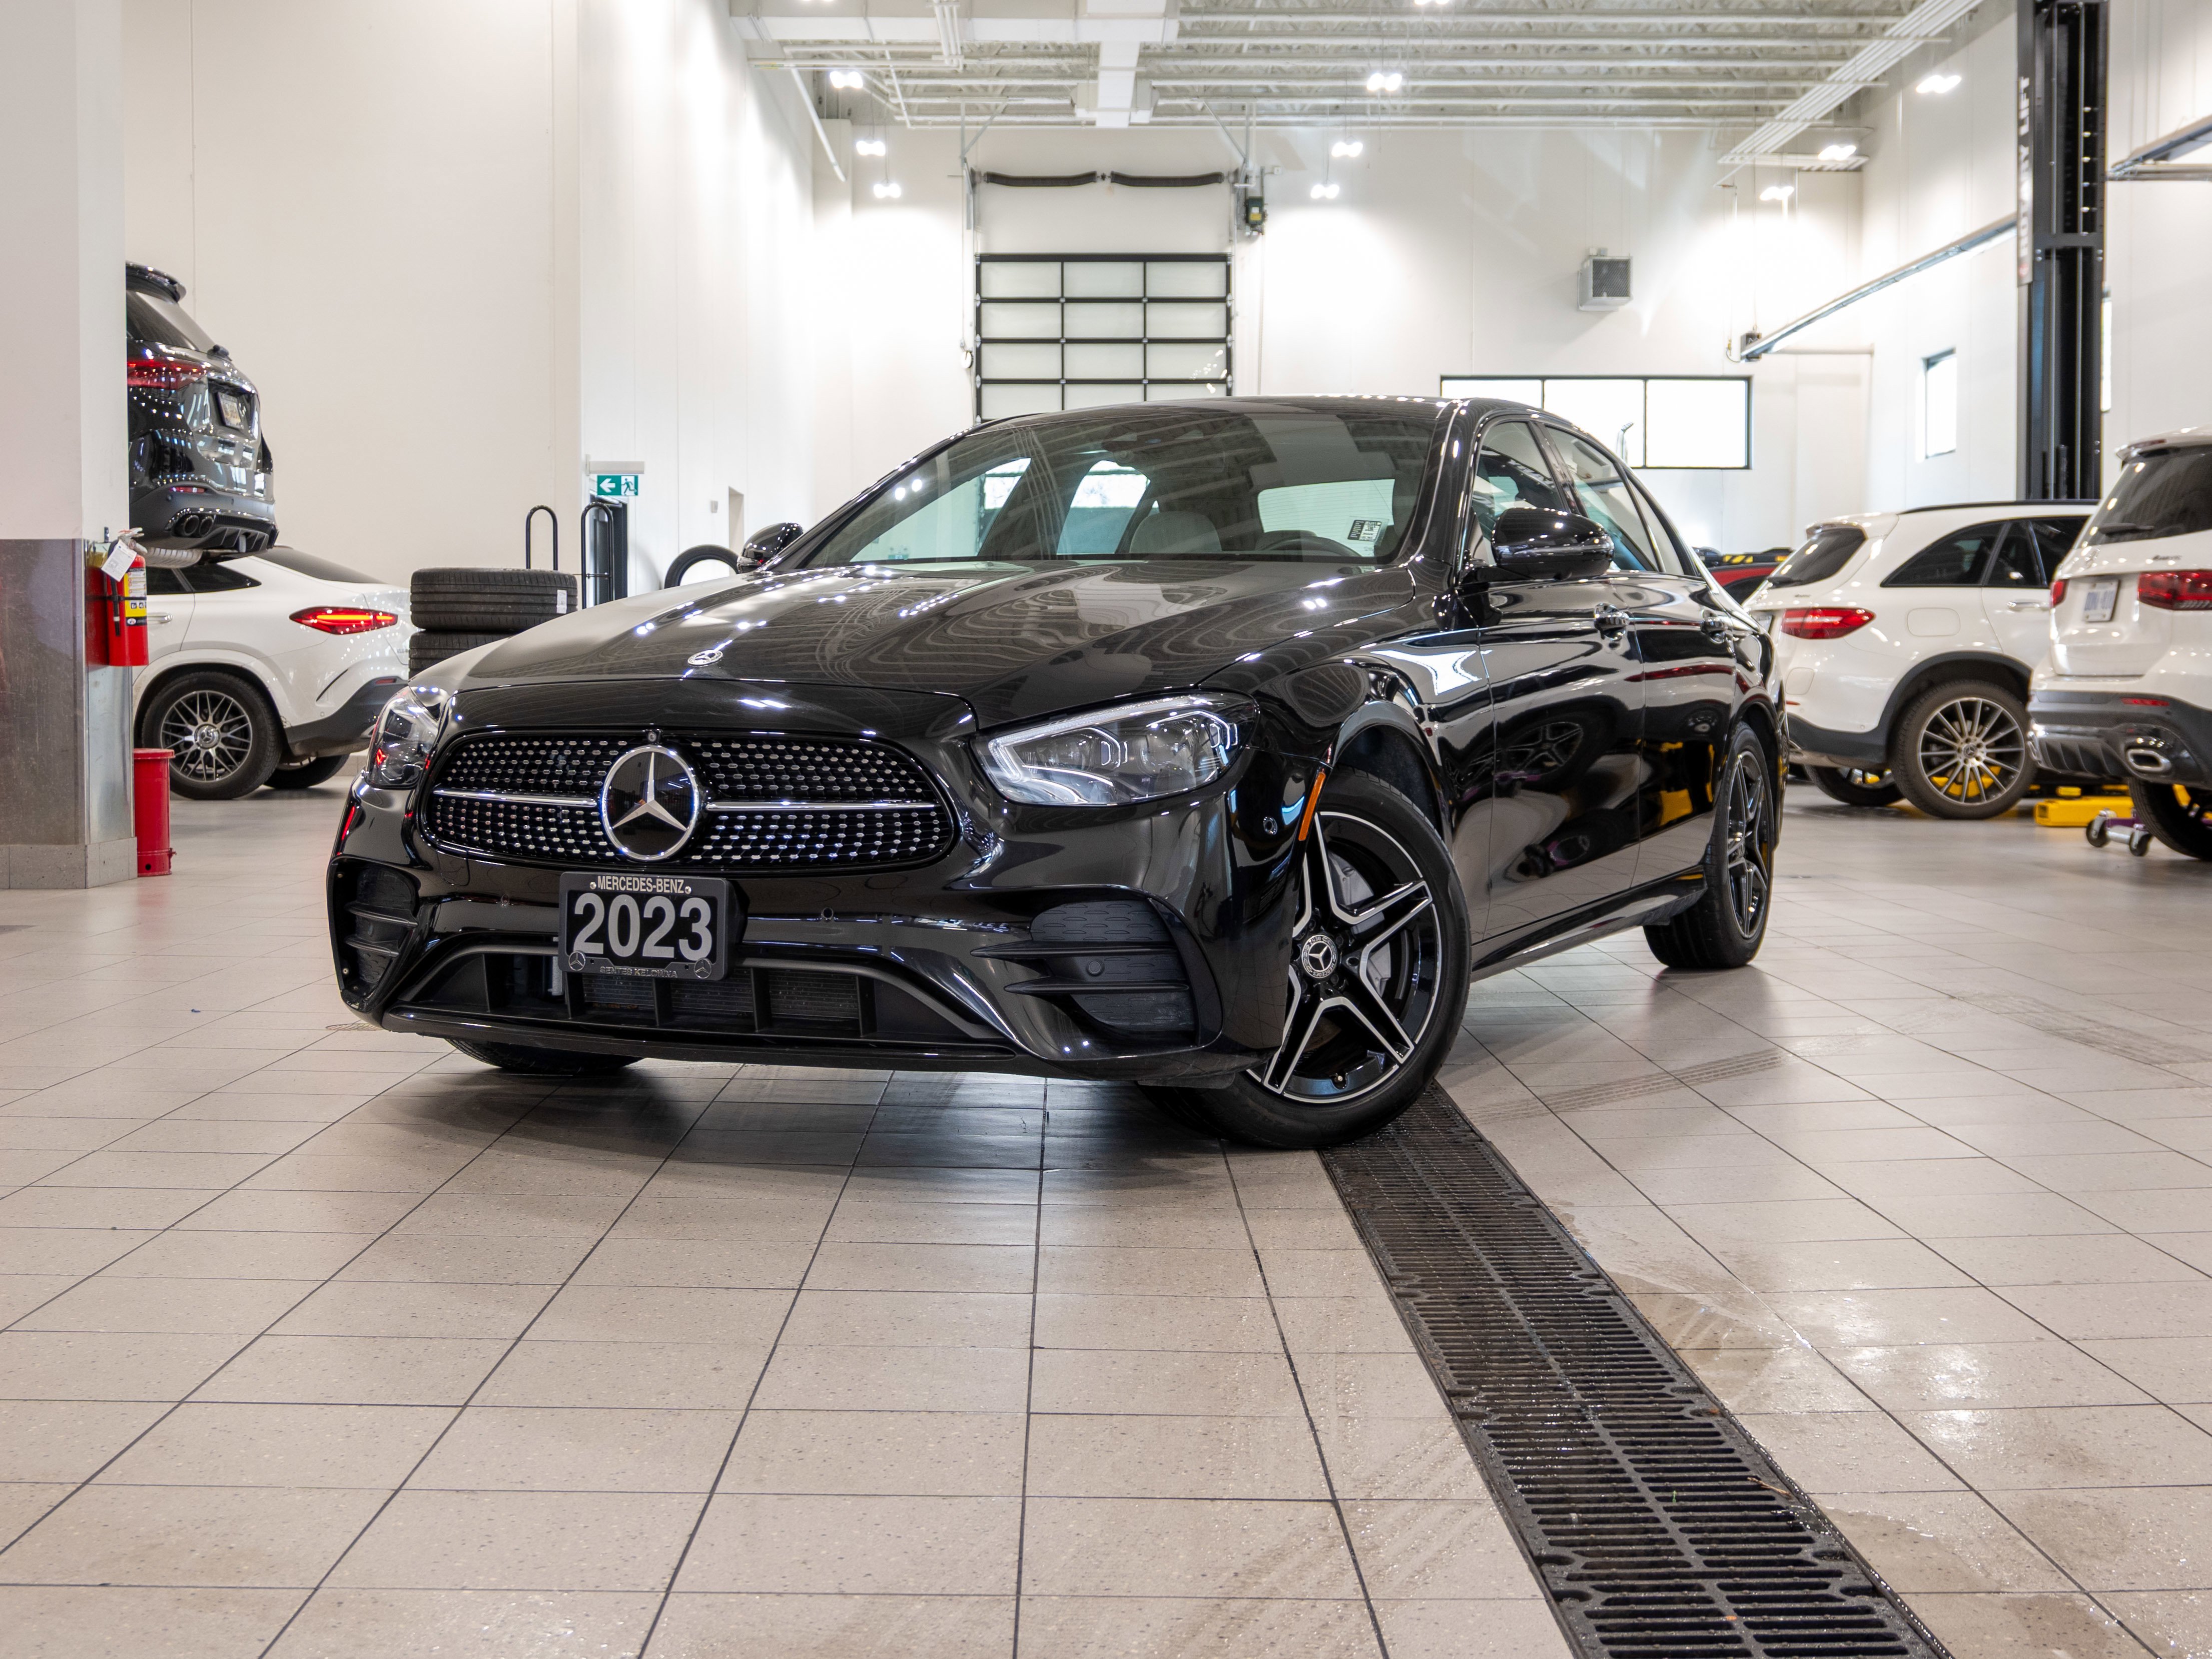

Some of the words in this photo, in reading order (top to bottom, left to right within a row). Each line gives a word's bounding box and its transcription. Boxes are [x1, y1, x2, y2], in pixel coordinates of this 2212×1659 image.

[2019, 77, 2030, 136] LIFT
[598, 876, 684, 893] MERCEDES-BENZ
[573, 893, 712, 962] 2023
[634, 968, 678, 978] KELOWNA
[1312, 963, 1335, 977] MERCEDES
